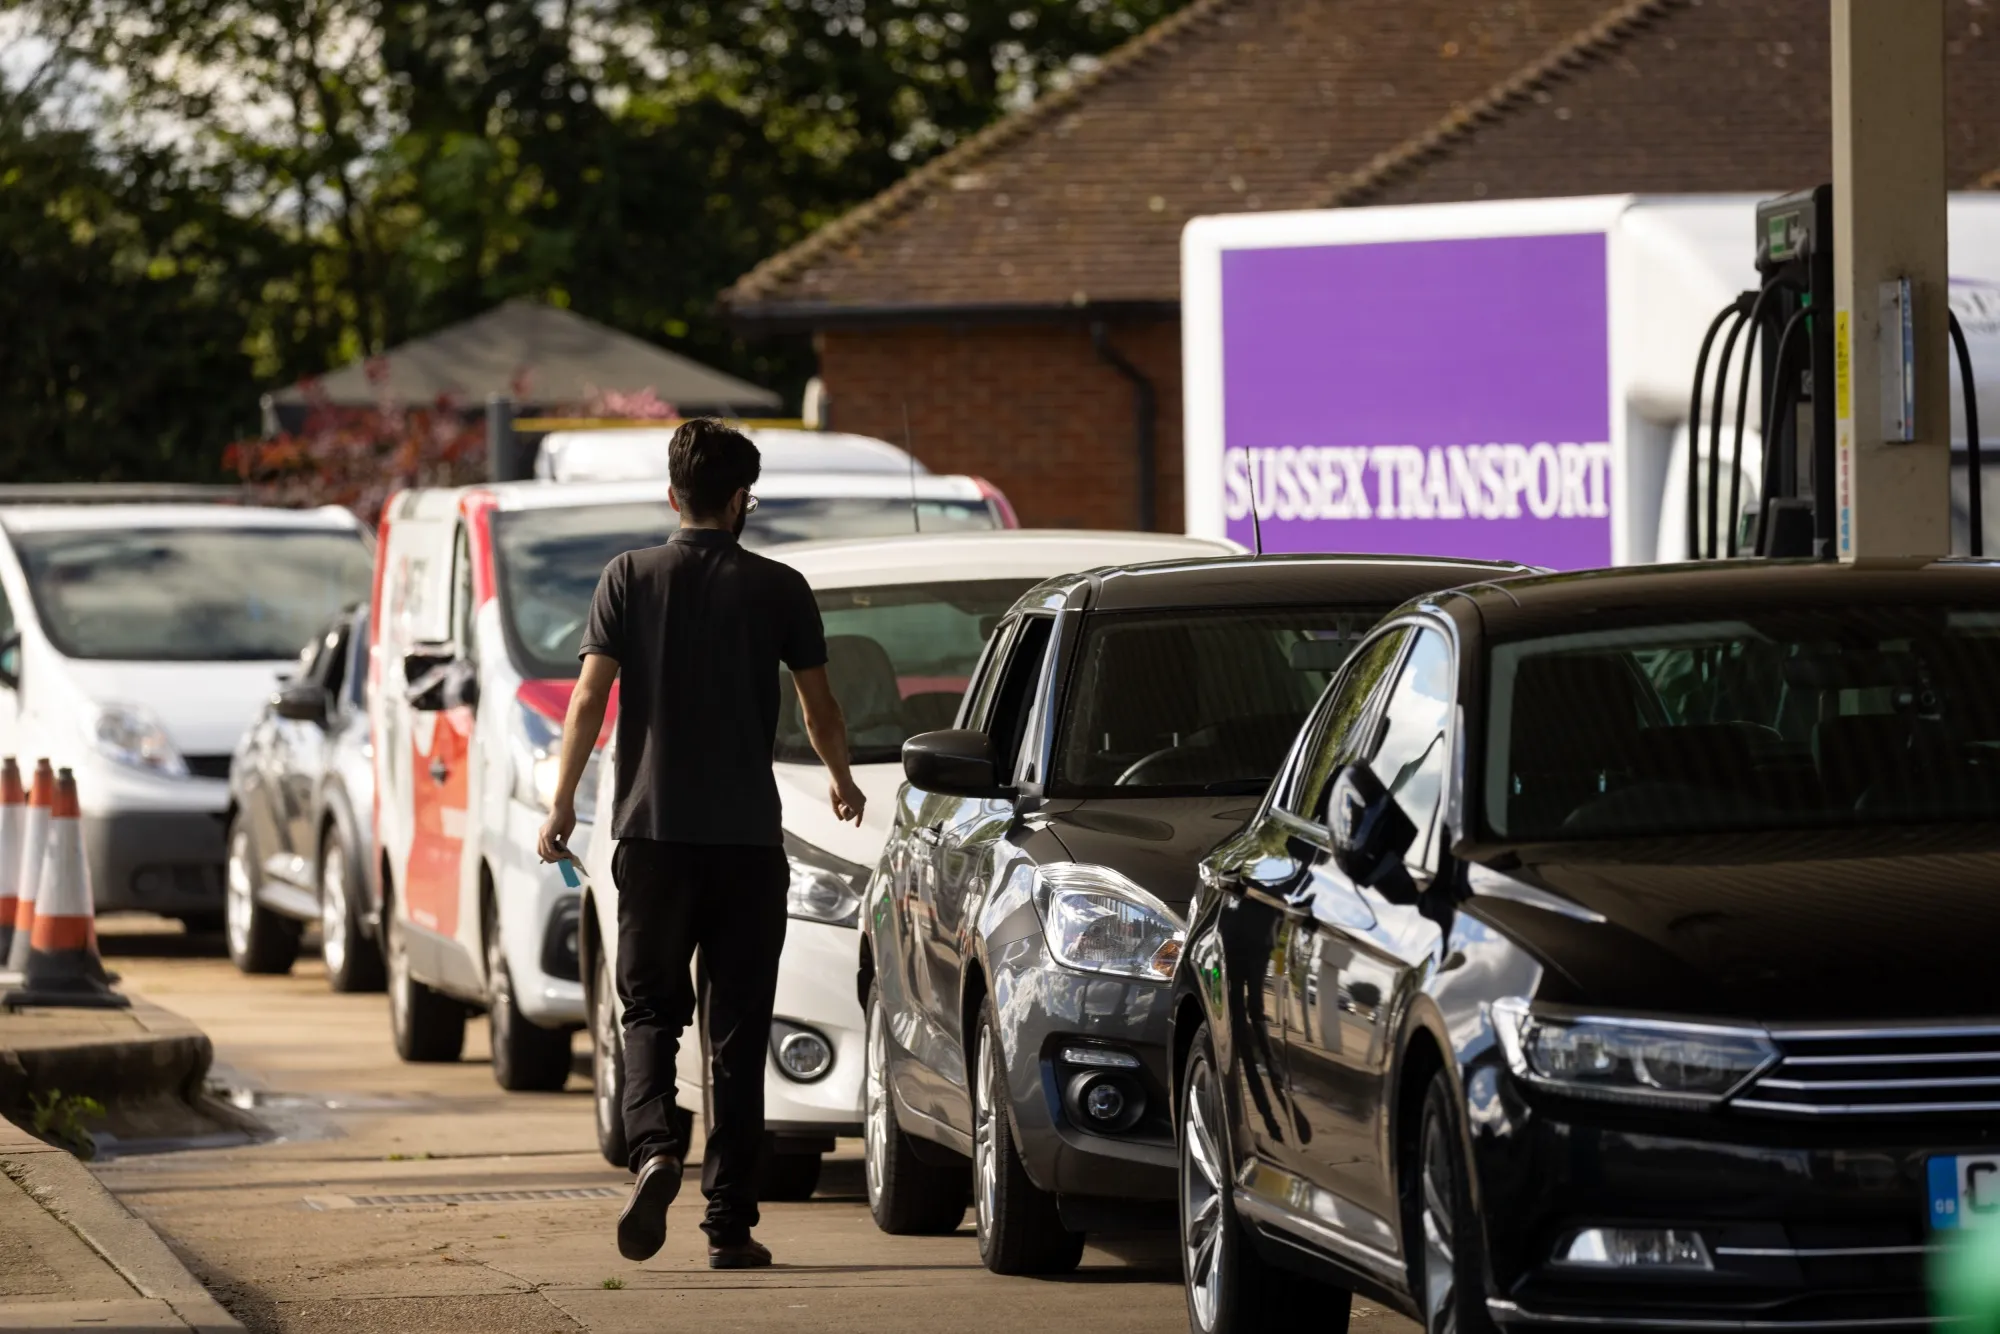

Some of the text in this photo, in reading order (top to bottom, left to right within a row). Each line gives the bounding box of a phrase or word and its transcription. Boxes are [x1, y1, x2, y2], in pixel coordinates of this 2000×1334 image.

[1225, 442, 1612, 520] SUSSEX TRANSPORT
[1935, 1199, 1955, 1214] GB
